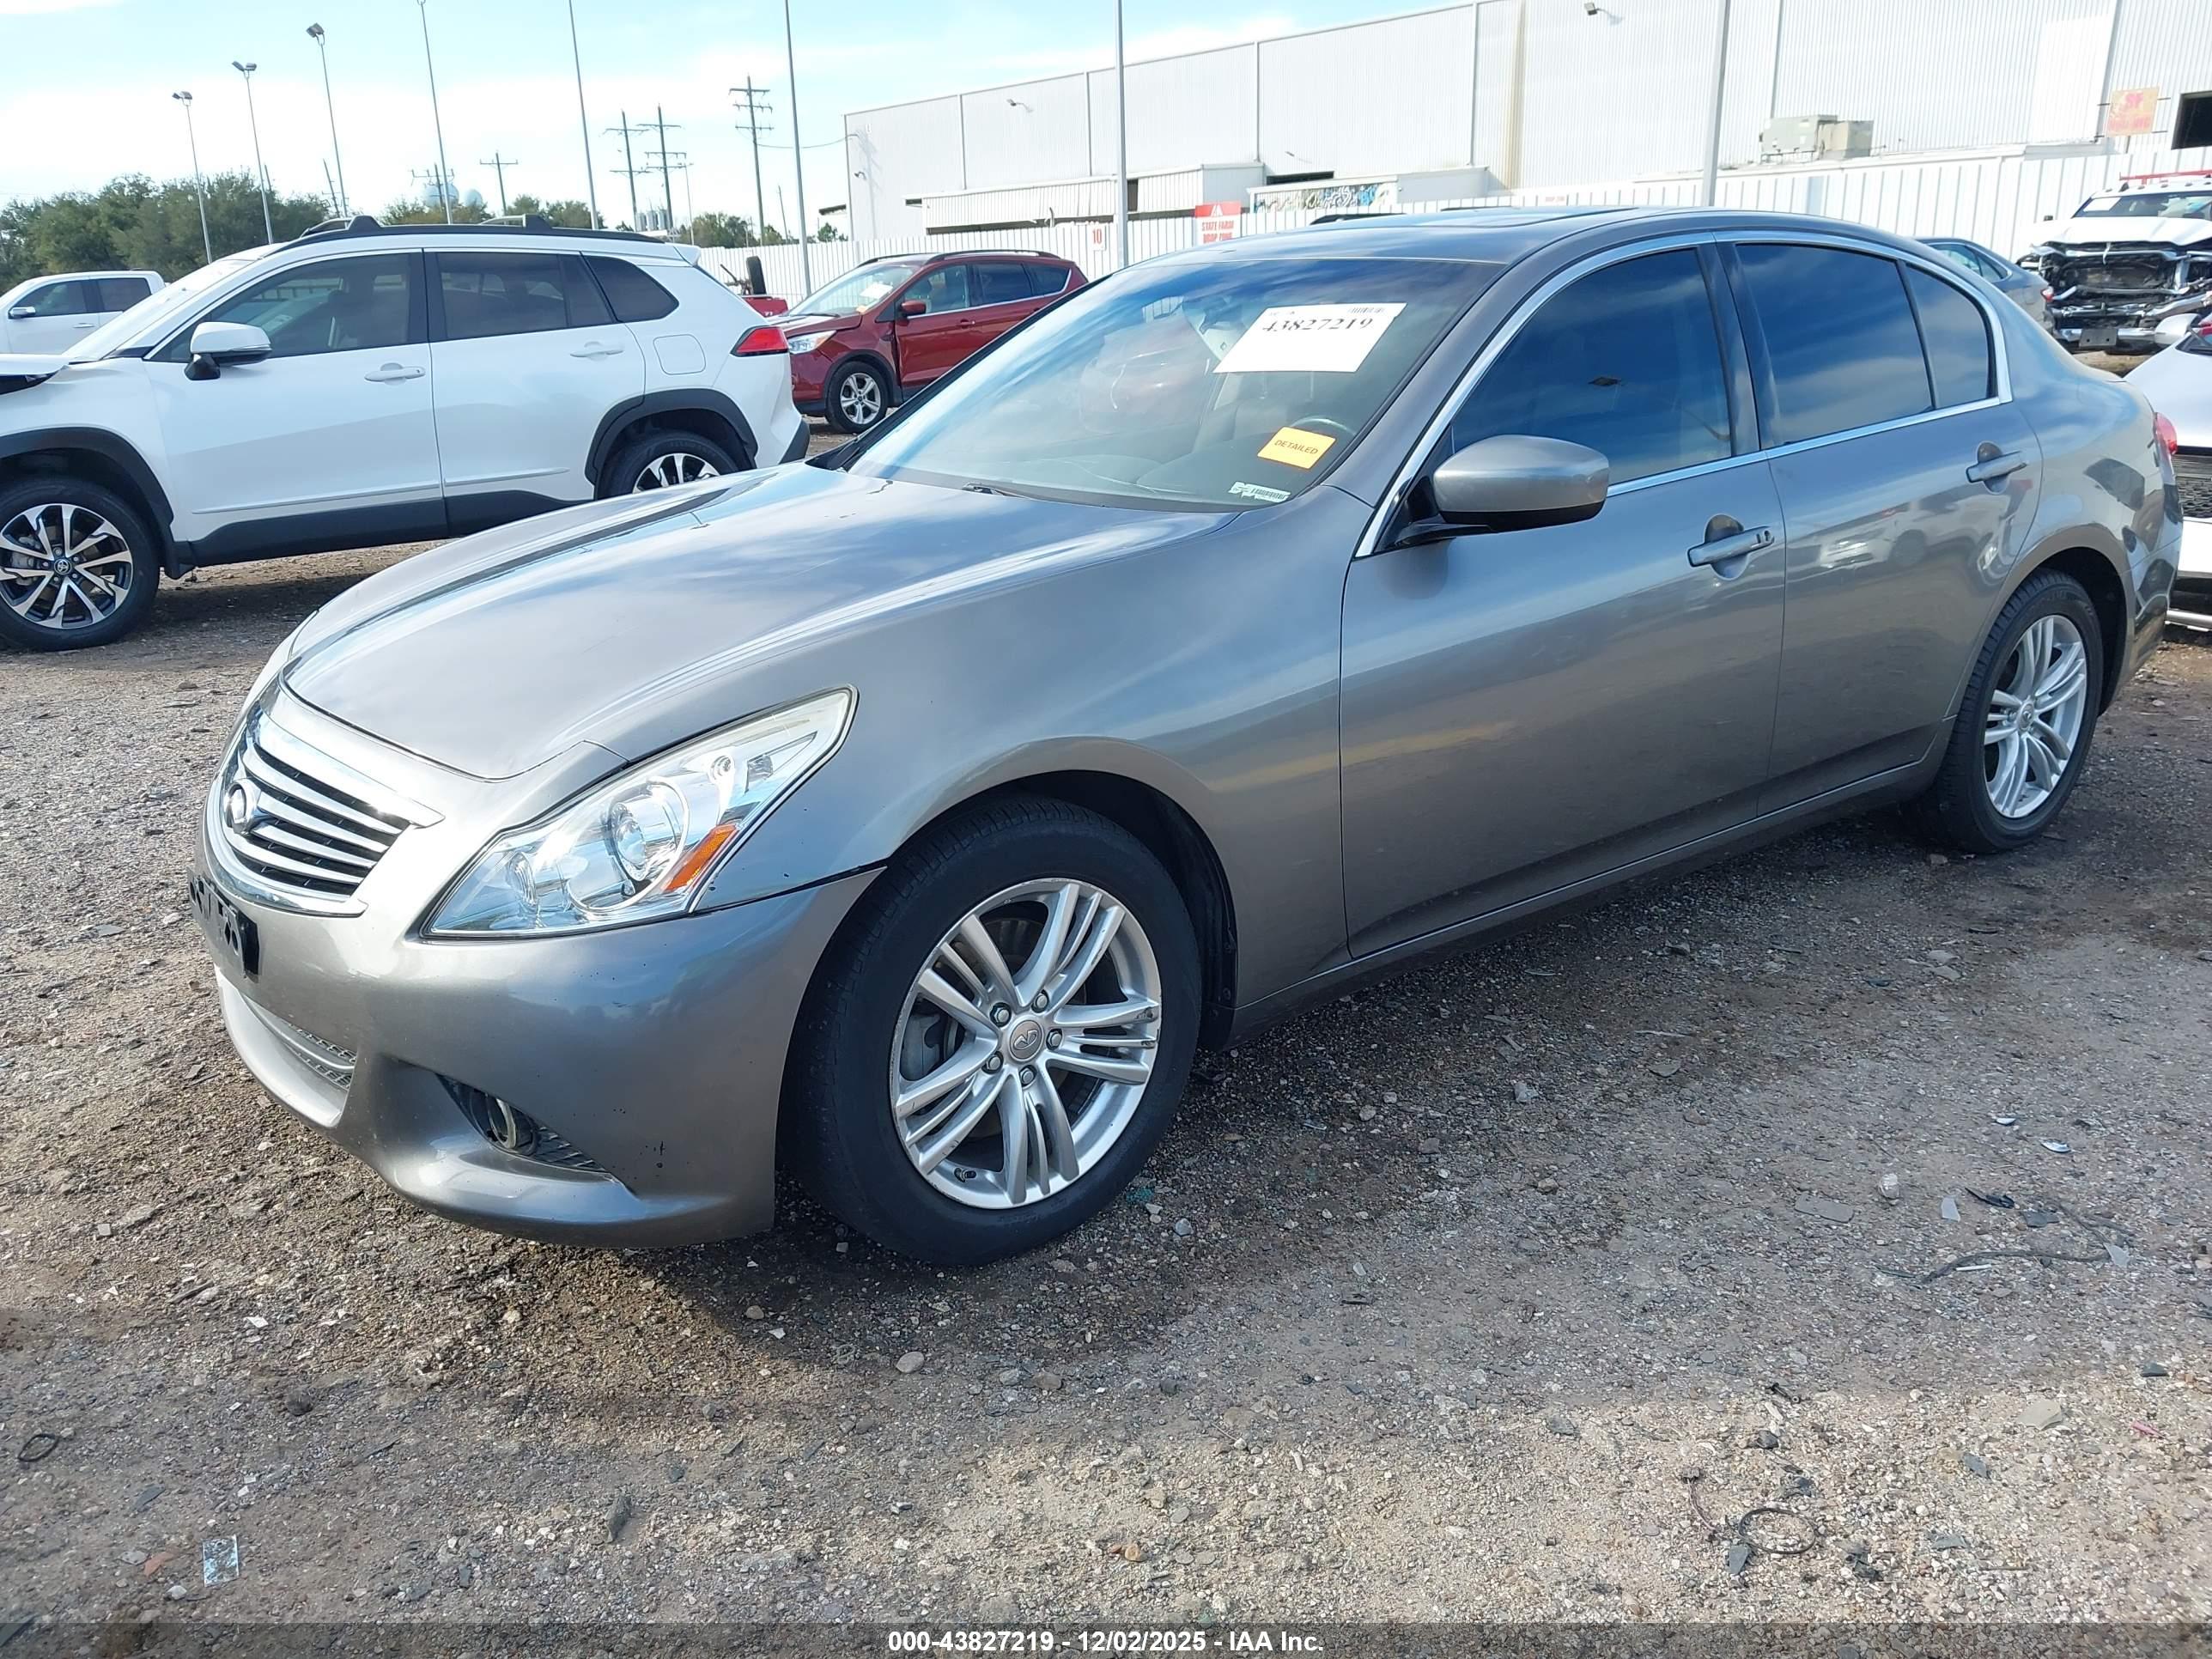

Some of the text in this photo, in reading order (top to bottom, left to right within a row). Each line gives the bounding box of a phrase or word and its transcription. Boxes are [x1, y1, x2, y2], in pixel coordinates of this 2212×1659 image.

[1201, 221, 1217, 232] STATE
[1092, 228, 1103, 244] 10
[1263, 318, 1373, 332] 43827219
[1274, 439, 1319, 454] DETAILED
